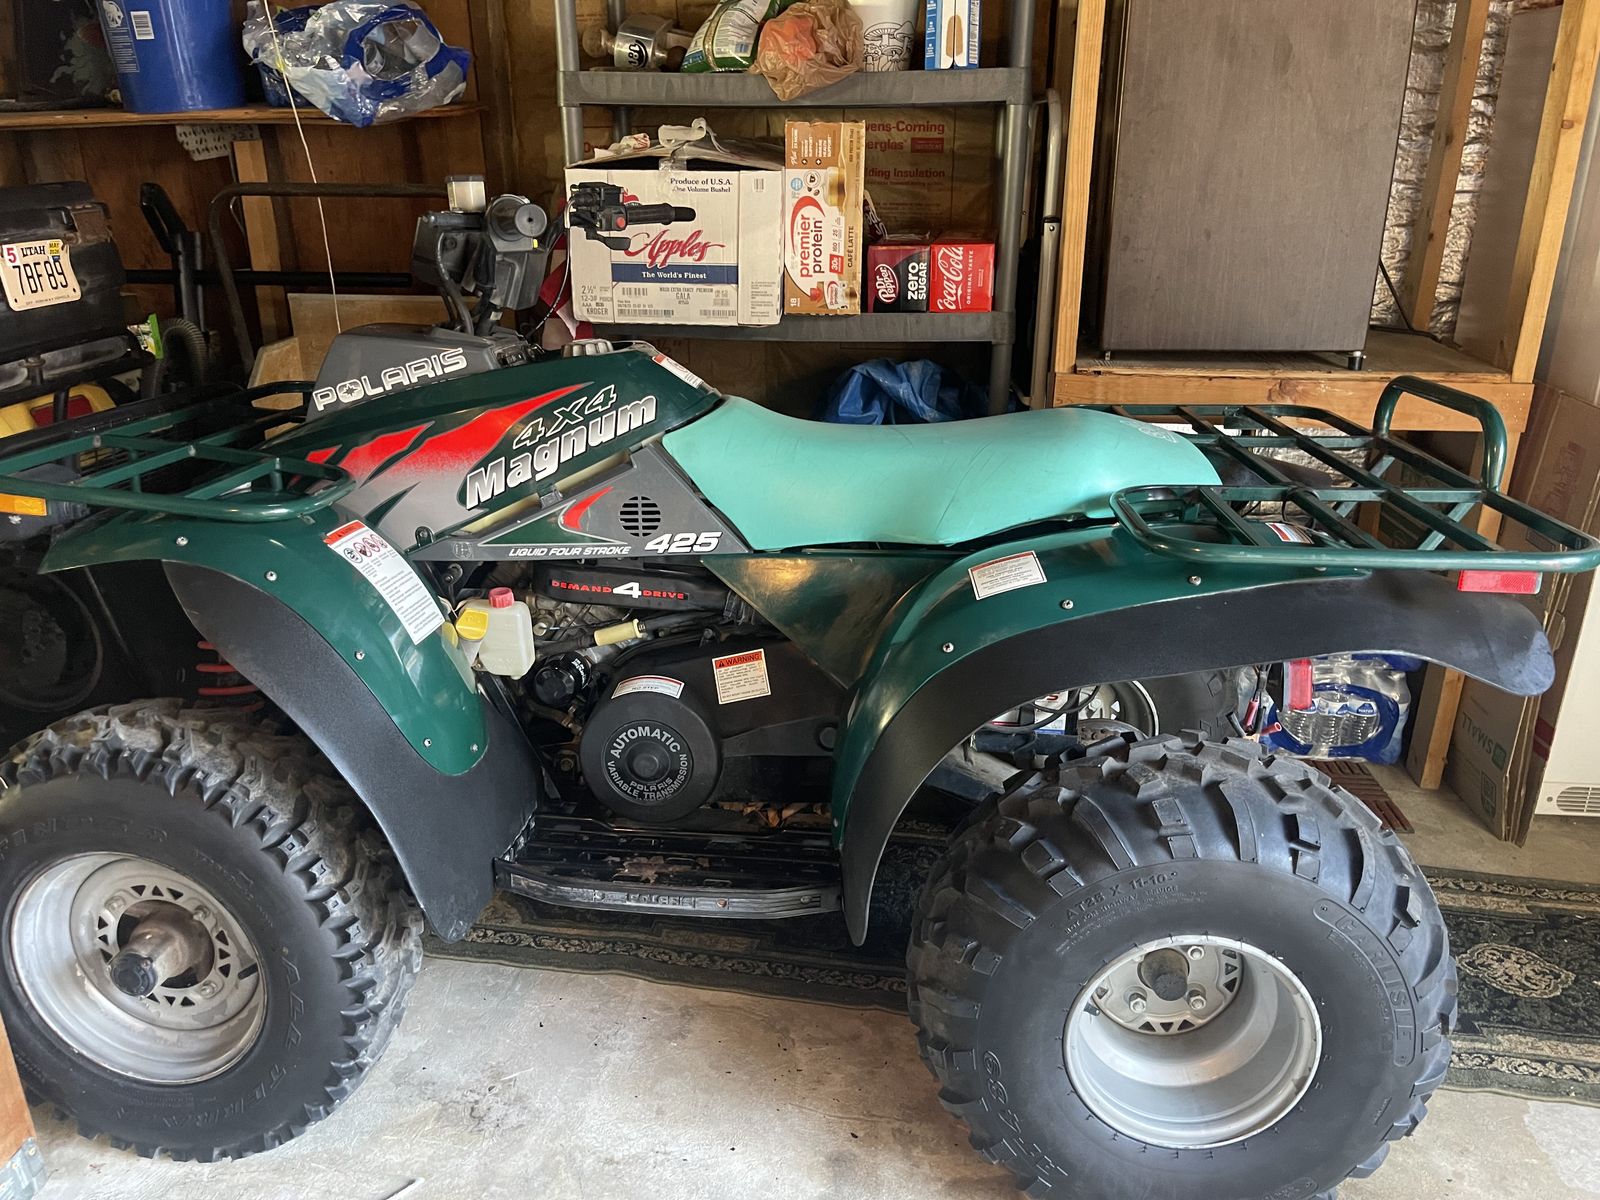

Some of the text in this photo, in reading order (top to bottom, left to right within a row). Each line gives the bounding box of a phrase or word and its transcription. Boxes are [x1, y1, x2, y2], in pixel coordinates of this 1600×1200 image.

[894, 168, 945, 178] Insulation
[6, 247, 17, 263] 5
[21, 245, 46, 257] UTAH
[624, 229, 726, 269] Apples
[797, 214, 813, 277] premier
[811, 218, 825, 273] protein
[12, 260, 68, 295] 7BF89
[641, 271, 655, 279] The
[656, 270, 683, 279] World's
[876, 275, 884, 289] Dr
[879, 267, 896, 301] Pepper
[908, 262, 919, 300] zero
[919, 262, 927, 300] SUGAR
[790, 297, 797, 307] 18
[313, 347, 467, 411] POLARIS
[513, 384, 617, 449] 4X4
[466, 395, 657, 510] Magnum
[508, 546, 632, 557] LIQUID FOUR STROKE
[644, 531, 723, 554] 425
[551, 579, 685, 600] DEMAND 4 DRIVE
[725, 654, 761, 666] WARNING
[610, 726, 680, 758] AUTOMATIC
[607, 753, 688, 801] VARIABLE TRANSMISSION
[630, 777, 673, 791] POLARIS
[1335, 913, 1413, 1040] CARLISLE
